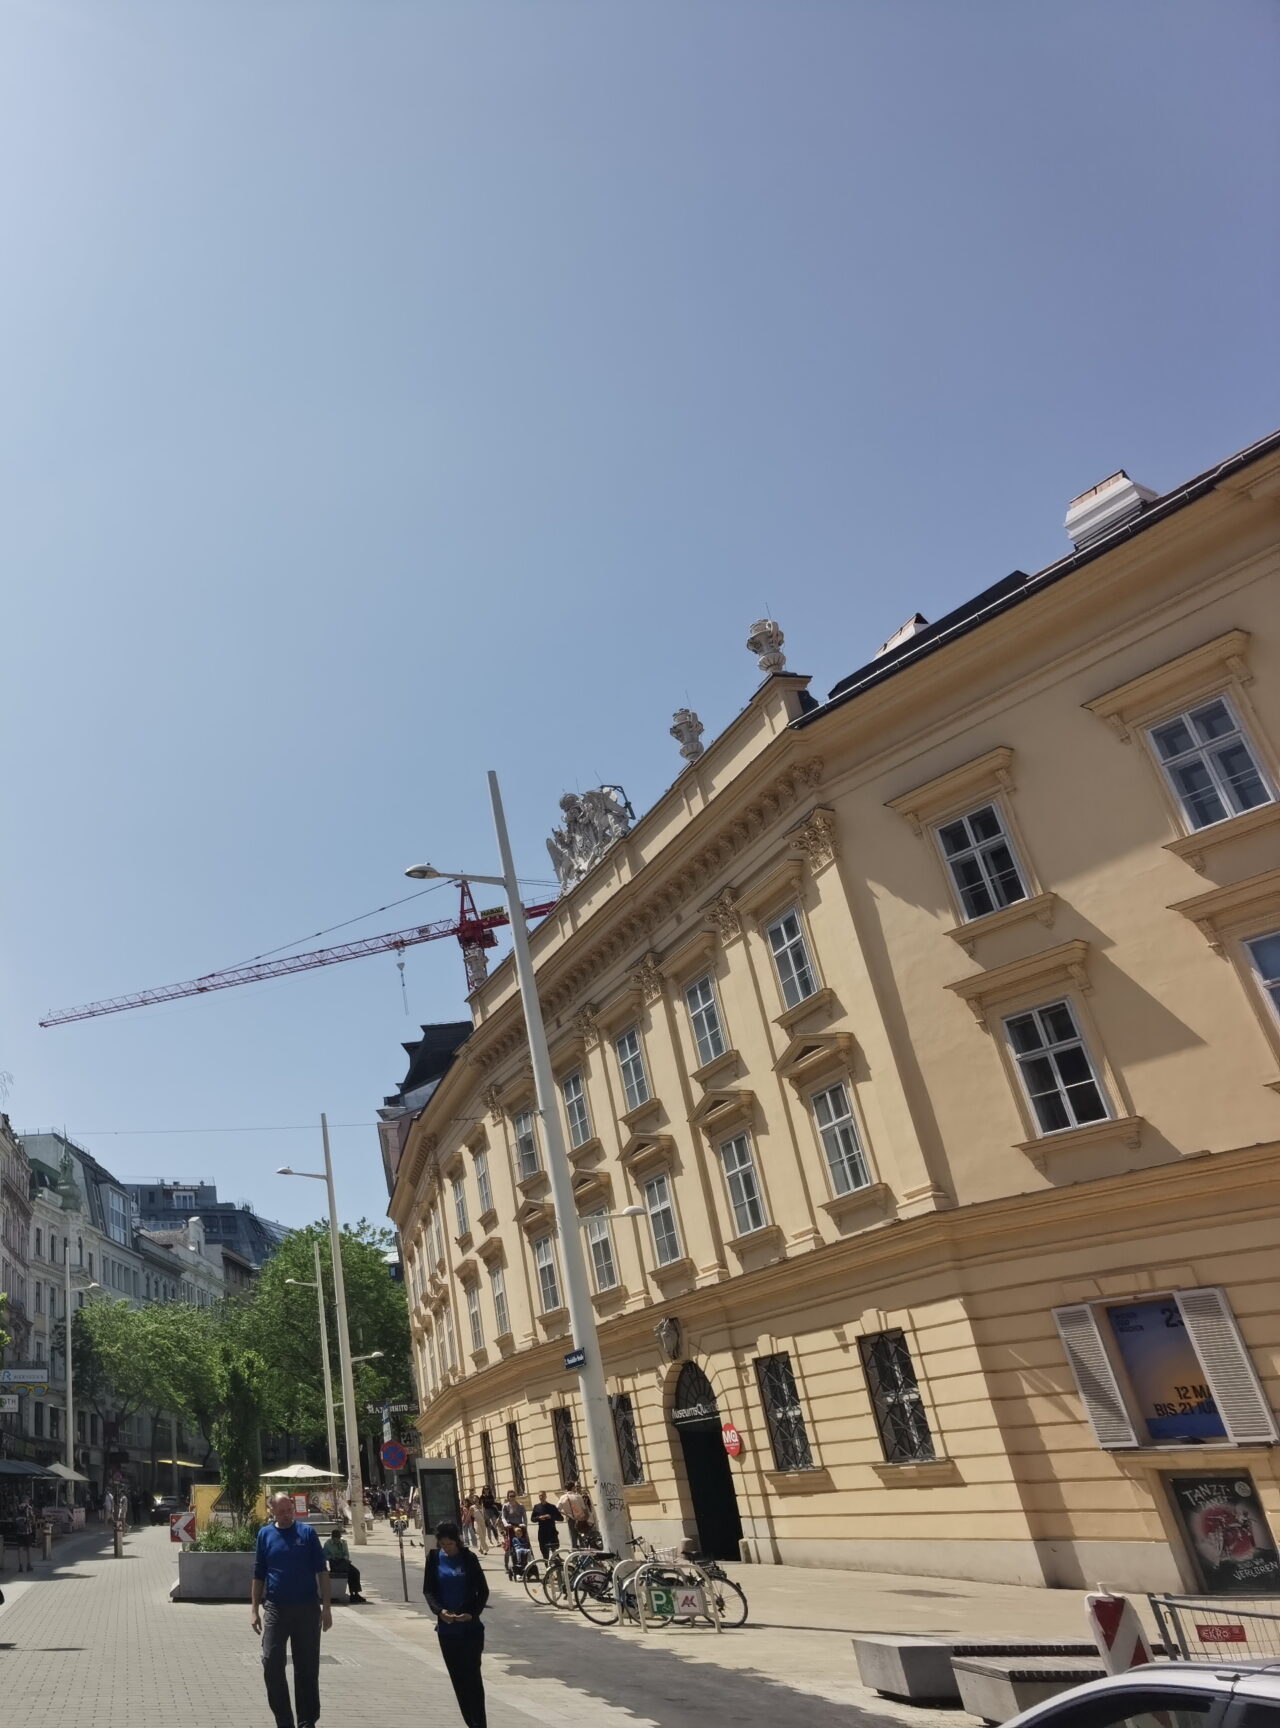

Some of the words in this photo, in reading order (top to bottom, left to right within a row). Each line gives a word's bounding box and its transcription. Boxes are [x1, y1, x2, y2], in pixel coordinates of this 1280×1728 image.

[1174, 1386, 1192, 1400] 12
[1154, 1402, 1177, 1417] BIS
[1179, 1402, 1194, 1416] 21
[722, 1429, 739, 1444] MQ
[1233, 1561, 1279, 1581] VERLOREN
[650, 1590, 667, 1612] P
